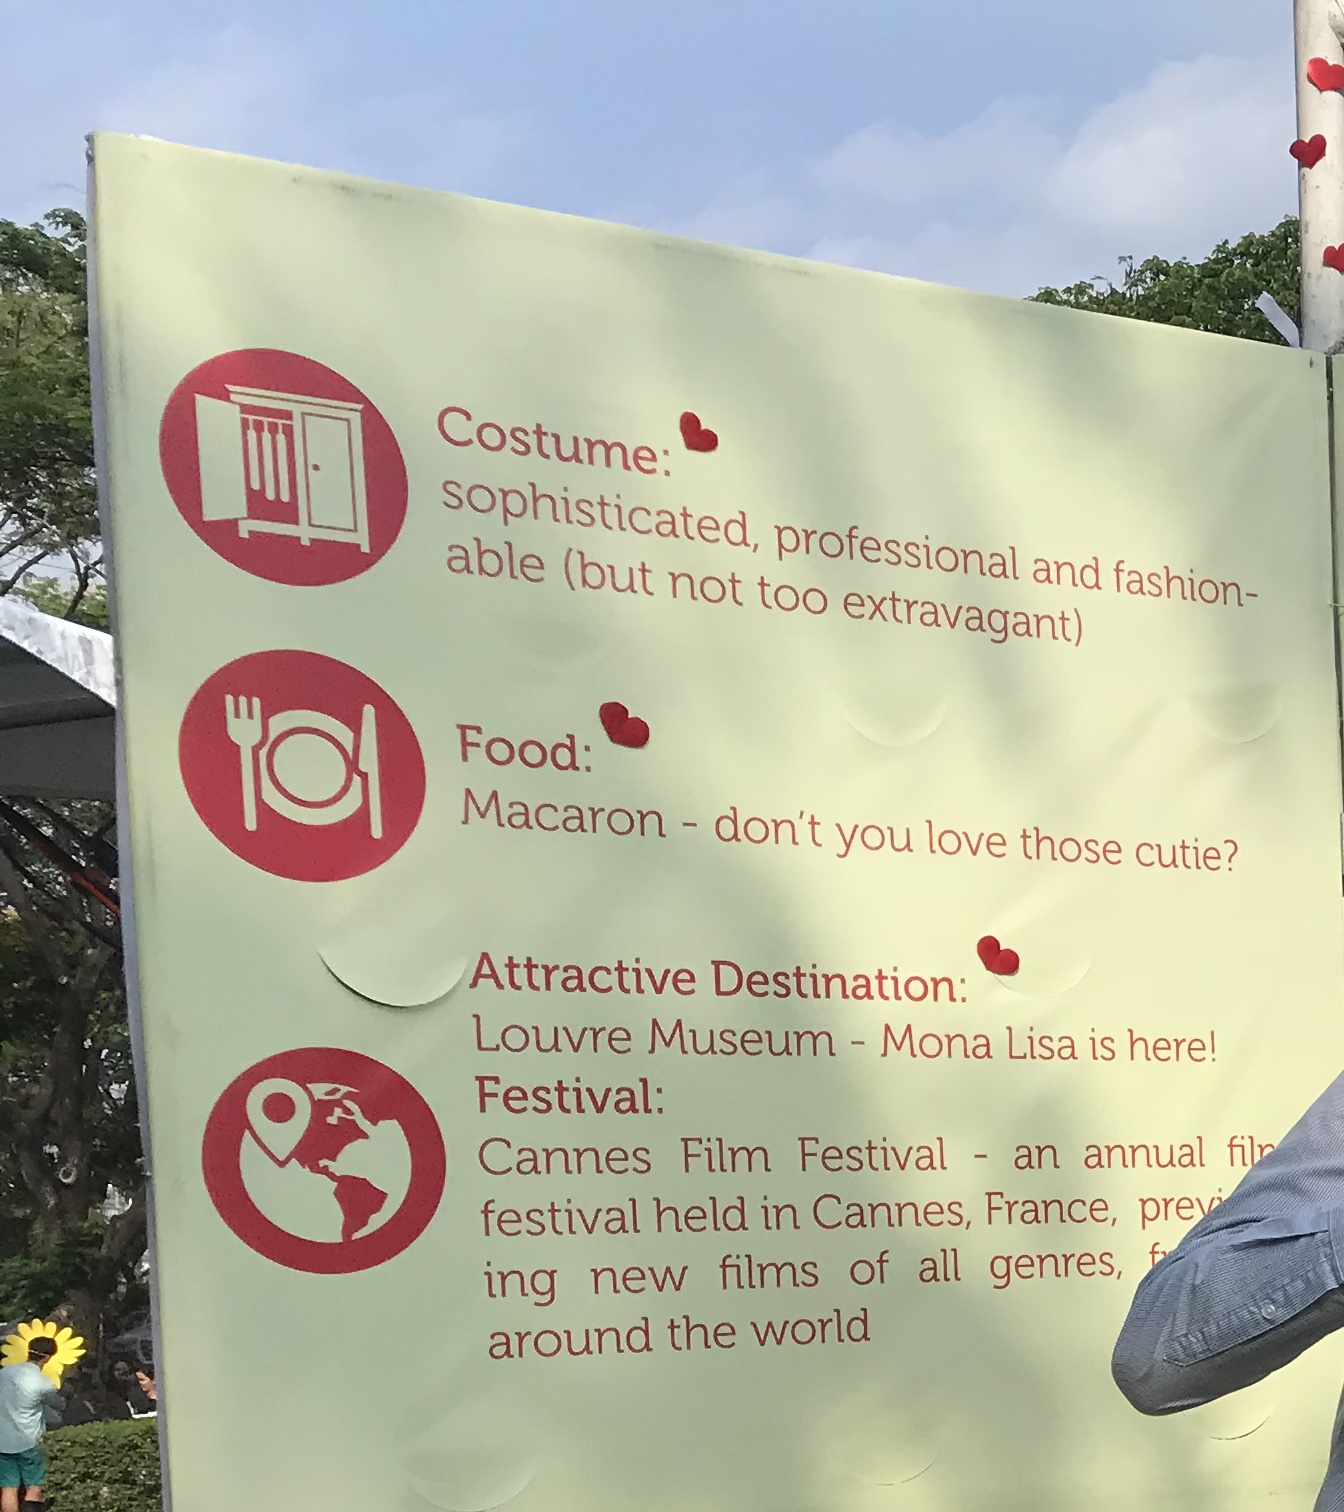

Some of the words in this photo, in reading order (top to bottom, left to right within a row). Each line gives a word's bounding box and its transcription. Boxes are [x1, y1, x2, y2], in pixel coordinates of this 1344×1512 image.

[437, 406, 669, 476] Costume:
[442, 477, 758, 552] sophisticated,
[775, 525, 1018, 579] professional
[1032, 557, 1101, 590] and
[1114, 560, 1259, 606] fashion-
[447, 538, 544, 582] able
[565, 550, 652, 595] (but
[669, 573, 742, 606] not
[759, 577, 828, 615] too
[843, 592, 1082, 646] extravagant)
[457, 724, 590, 771] Food:
[462, 788, 666, 837] Macaron
[715, 806, 821, 848] don't
[836, 823, 913, 858] you
[926, 819, 1007, 859] love
[1021, 826, 1122, 866] those
[1135, 839, 1239, 871] cutie?
[470, 952, 696, 996] Attractive
[711, 959, 966, 1003] Destination:
[473, 1014, 631, 1054] Louvre
[649, 1019, 834, 1056] Museum
[881, 1024, 992, 1060] Mona
[1006, 1026, 1078, 1060] Lisa
[1090, 1030, 1116, 1061] is
[1128, 1028, 1215, 1062] here!
[476, 1075, 663, 1115] Festival:
[478, 1137, 652, 1176] Cannes
[681, 1137, 769, 1172] Film
[799, 1136, 947, 1171] Festival
[1014, 1144, 1059, 1170] an
[1084, 1136, 1205, 1170] annual
[482, 1198, 640, 1237] festival
[656, 1196, 747, 1232] held
[762, 1196, 799, 1229] in
[813, 1194, 970, 1230] Cannes,
[986, 1191, 1117, 1225] France,
[485, 1262, 557, 1307] ing
[592, 1266, 687, 1293] new
[720, 1255, 818, 1289] films
[850, 1250, 887, 1285] of
[918, 1248, 960, 1283] all
[990, 1251, 1122, 1290] genres,
[488, 1317, 652, 1360] around
[669, 1315, 736, 1350] the
[752, 1308, 869, 1346] world
